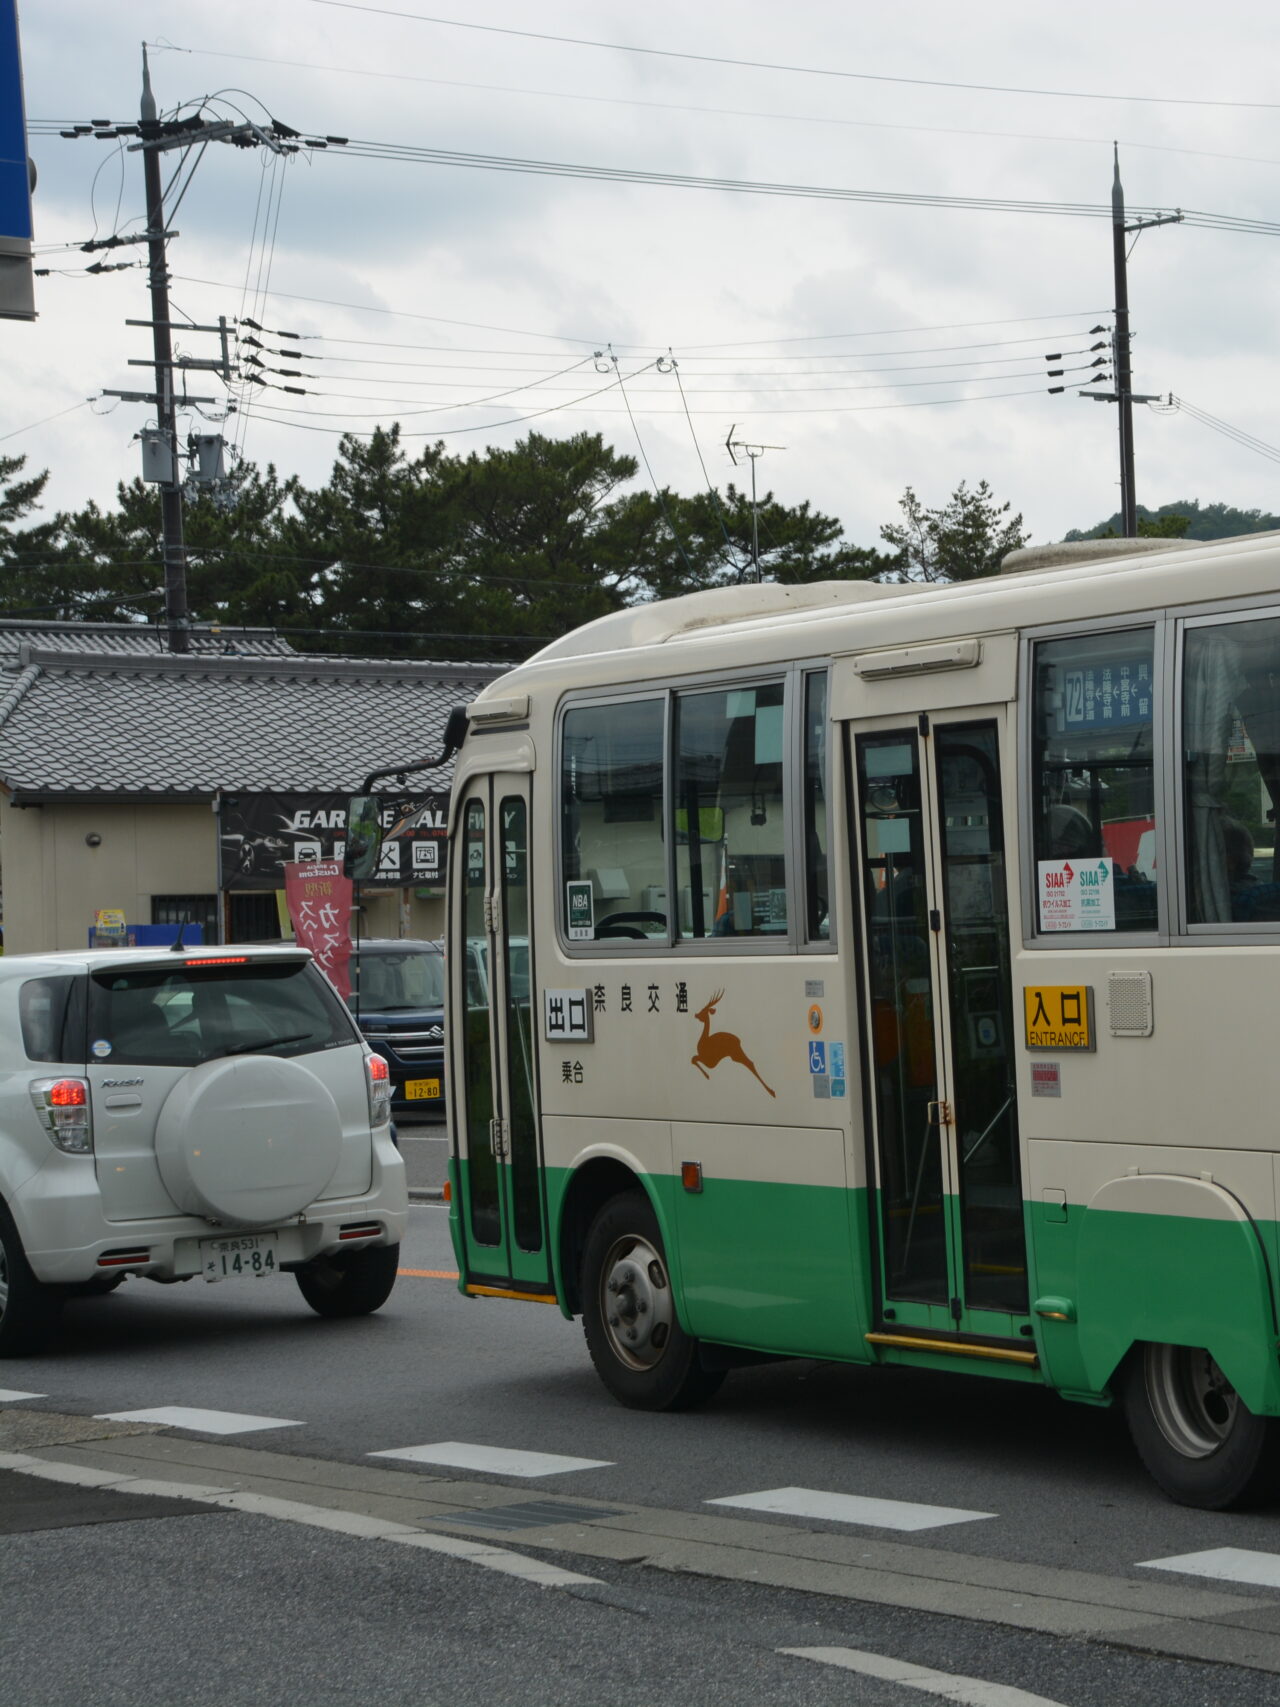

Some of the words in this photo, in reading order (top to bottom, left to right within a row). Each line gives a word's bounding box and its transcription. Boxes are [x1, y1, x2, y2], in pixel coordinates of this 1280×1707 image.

[1067, 676, 1082, 717] 72
[1120, 666, 1130, 717] 中宮寺前
[294, 809, 395, 828] GARE
[413, 871, 439, 879] ナビ取付
[1046, 872, 1064, 888] SIAA
[1080, 870, 1099, 887] SIAA
[572, 894, 588, 908] NBA
[594, 982, 688, 1013] 奈良交通
[1032, 991, 1082, 1027] 入口
[549, 997, 585, 1033] 出口
[562, 1060, 584, 1084] 乗合
[221, 1249, 275, 1275] 14-84
